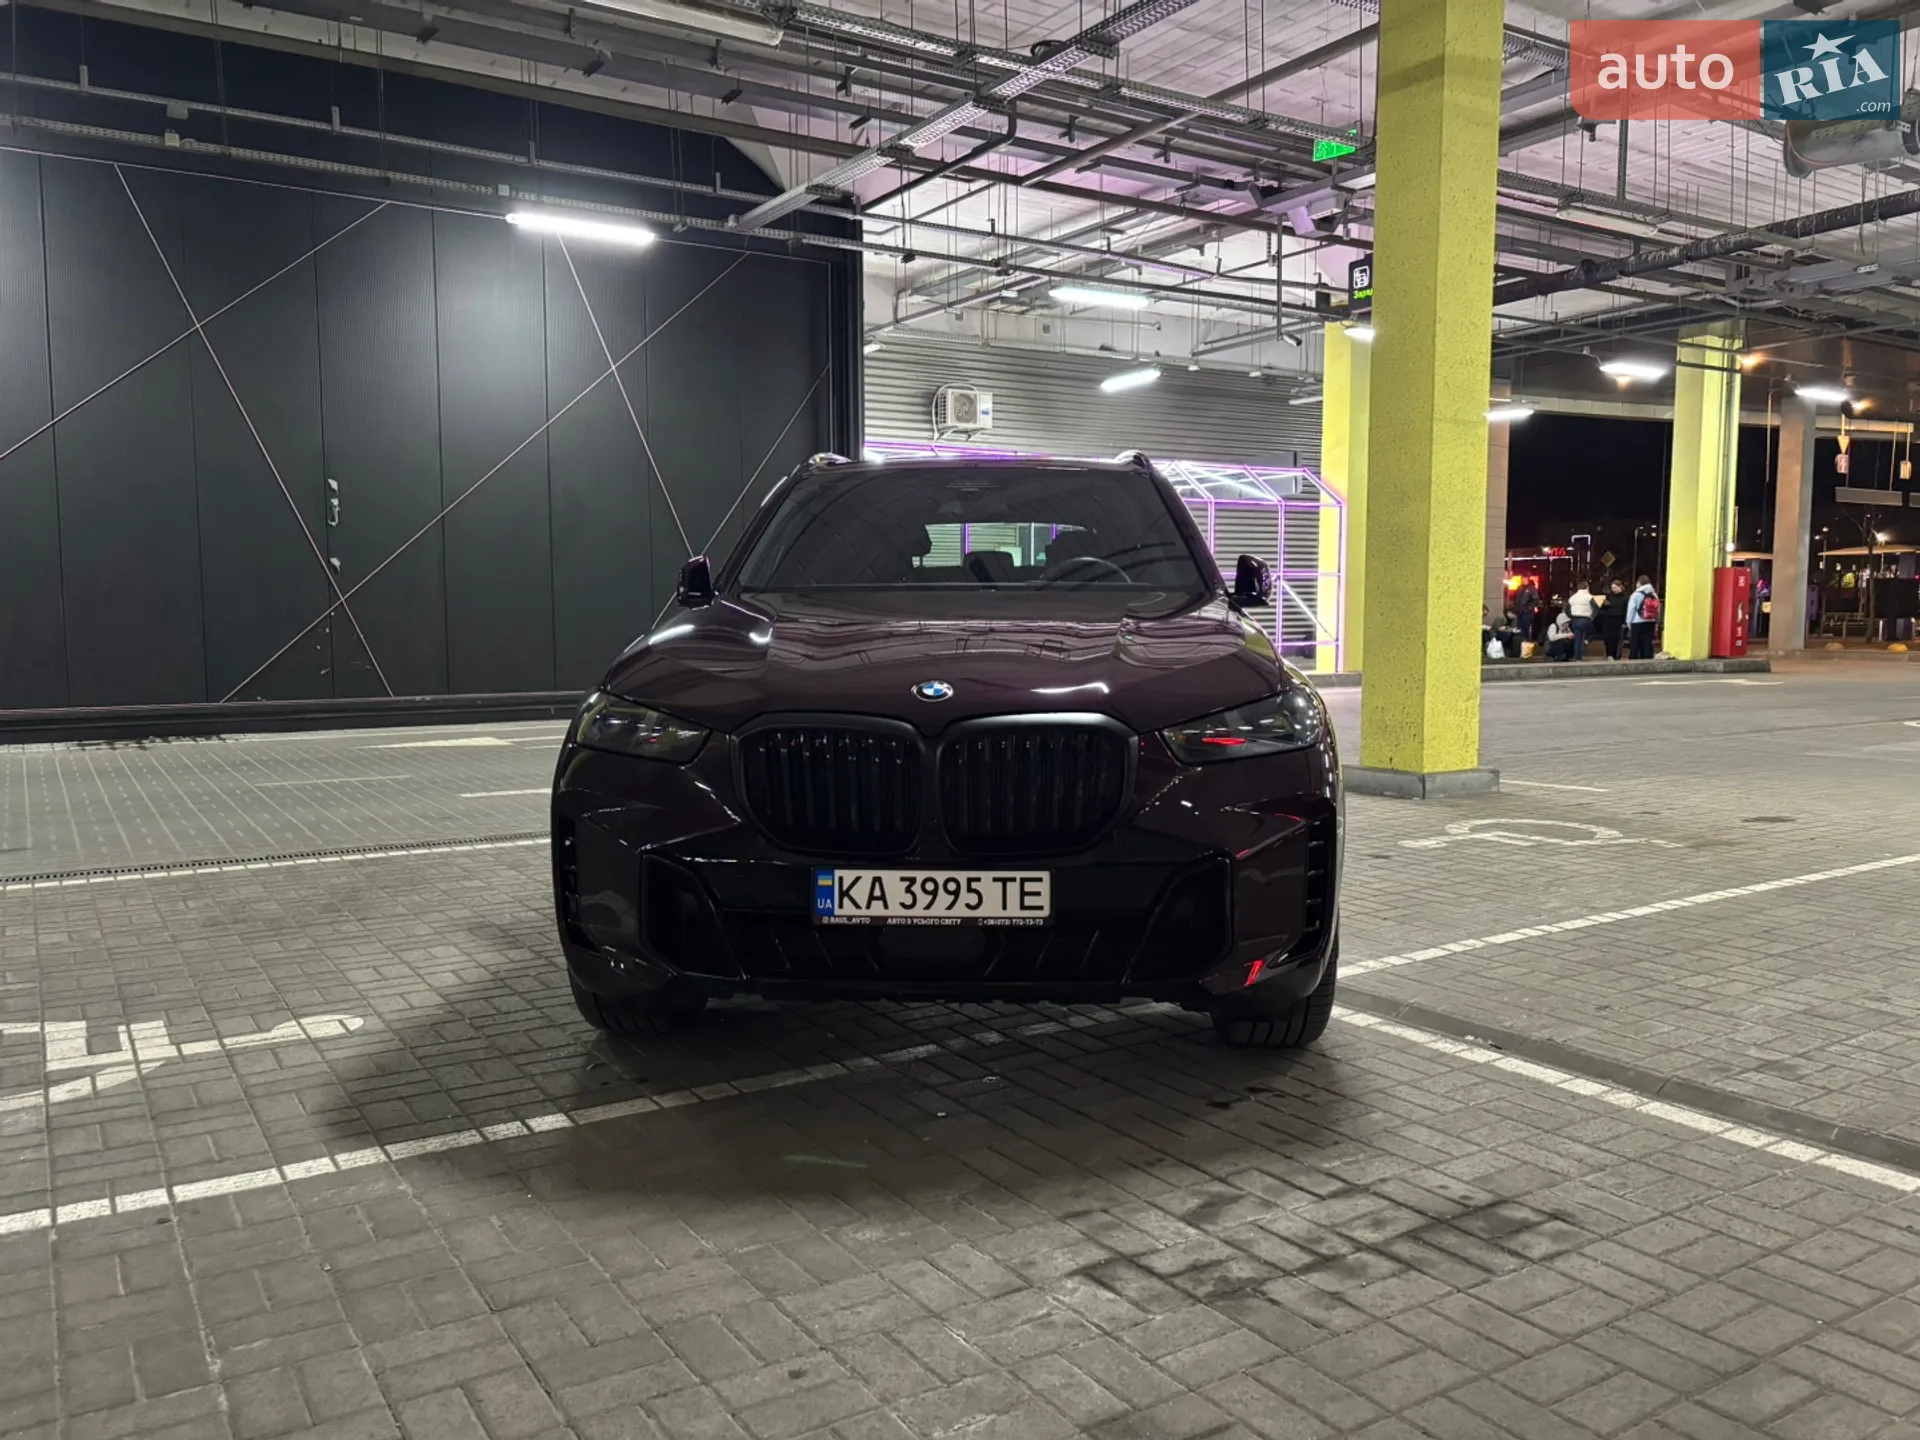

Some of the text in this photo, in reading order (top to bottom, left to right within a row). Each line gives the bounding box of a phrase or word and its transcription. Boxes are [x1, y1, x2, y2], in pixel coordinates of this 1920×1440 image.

[817, 898, 833, 909] UA
[837, 876, 1045, 911] KA 3995 TE
